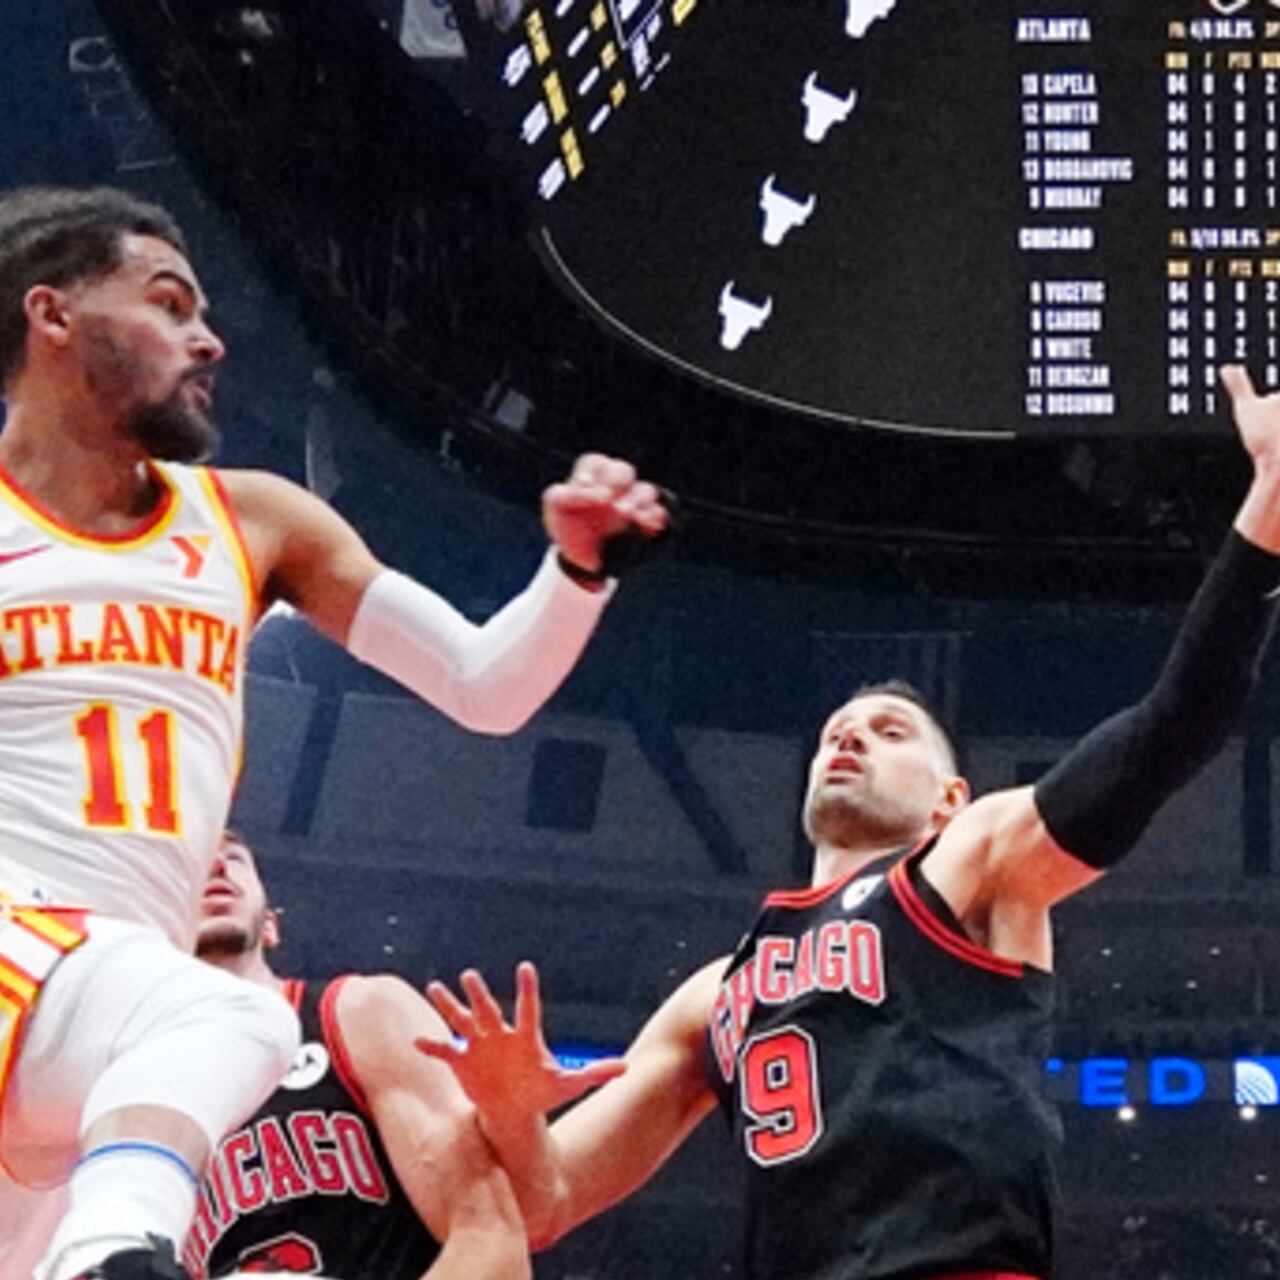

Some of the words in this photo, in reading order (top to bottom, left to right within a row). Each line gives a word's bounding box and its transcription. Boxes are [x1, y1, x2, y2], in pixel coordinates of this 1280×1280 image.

[1017, 19, 1090, 40] ATLANTA
[1043, 74, 1095, 95] CAPELA
[1235, 74, 1244, 94] 4
[74, 702, 182, 839] 11
[739, 1024, 823, 1167] 9
[1047, 1056, 1206, 1106] ED
